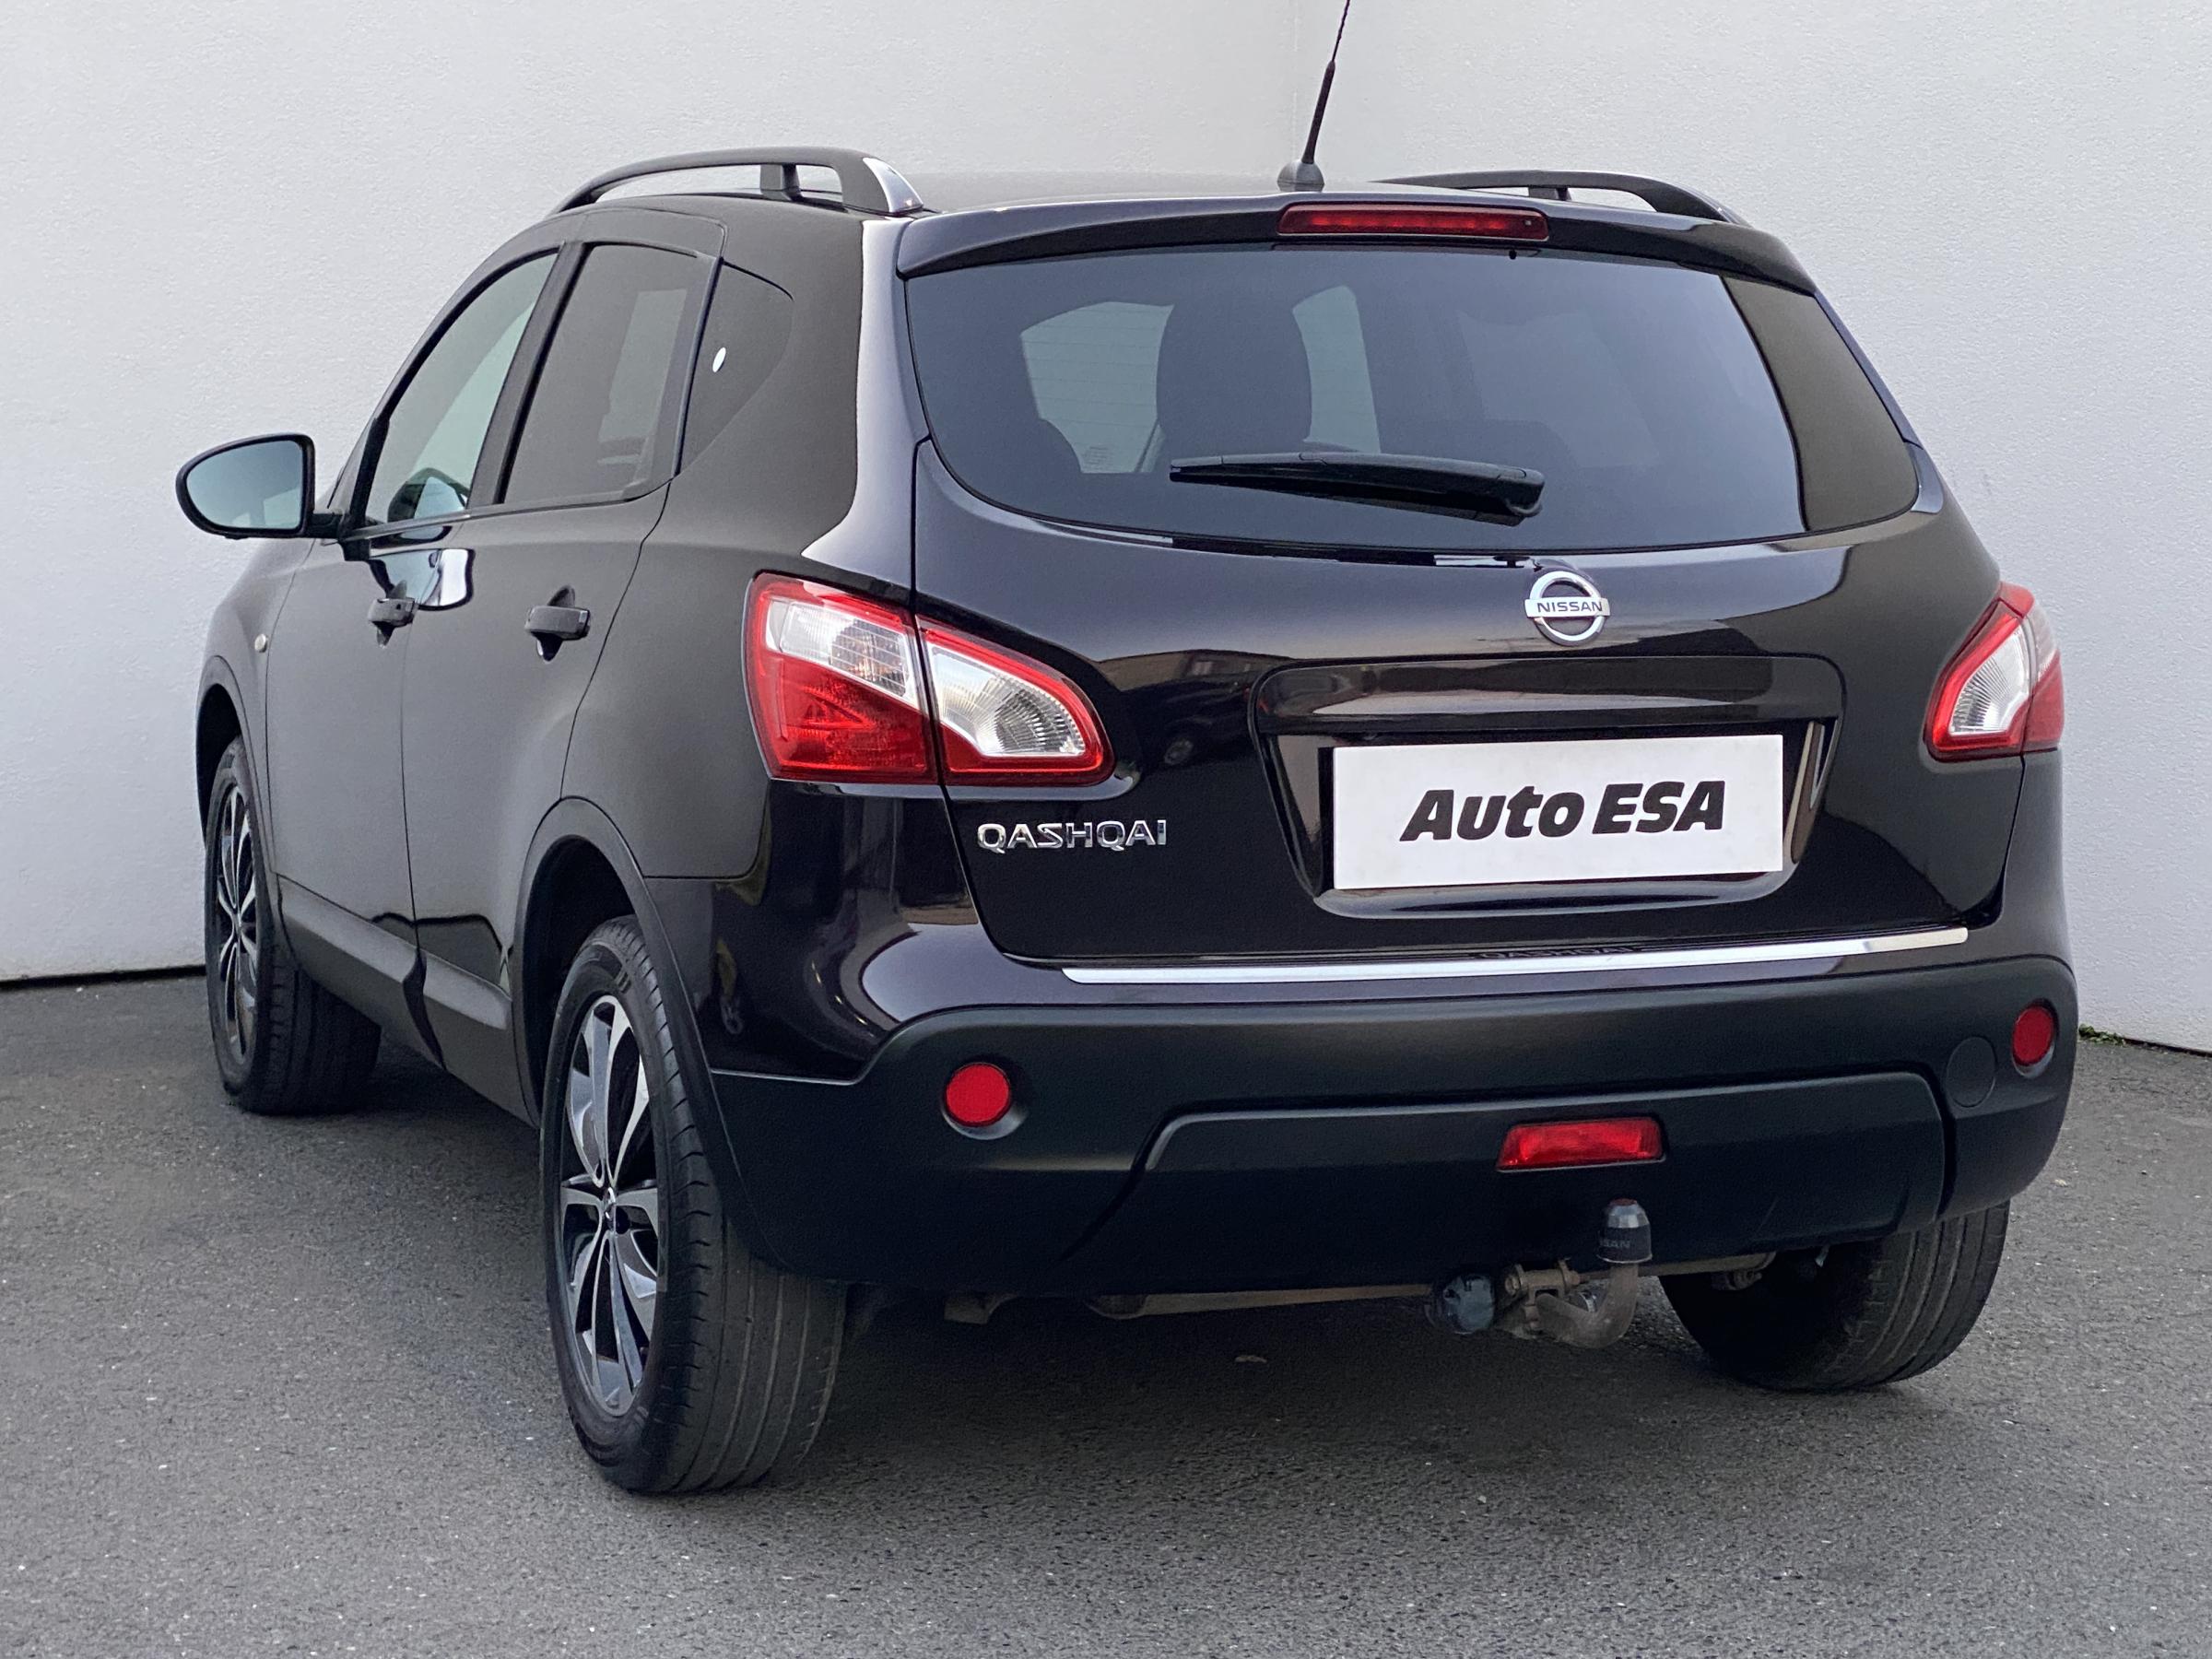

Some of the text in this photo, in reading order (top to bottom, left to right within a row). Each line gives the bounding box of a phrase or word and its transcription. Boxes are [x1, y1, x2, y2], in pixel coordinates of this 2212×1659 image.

[1536, 601, 1603, 613] NISSAN
[1399, 780, 1725, 842] Auto ESA
[977, 819, 1167, 854] QASHQAI
